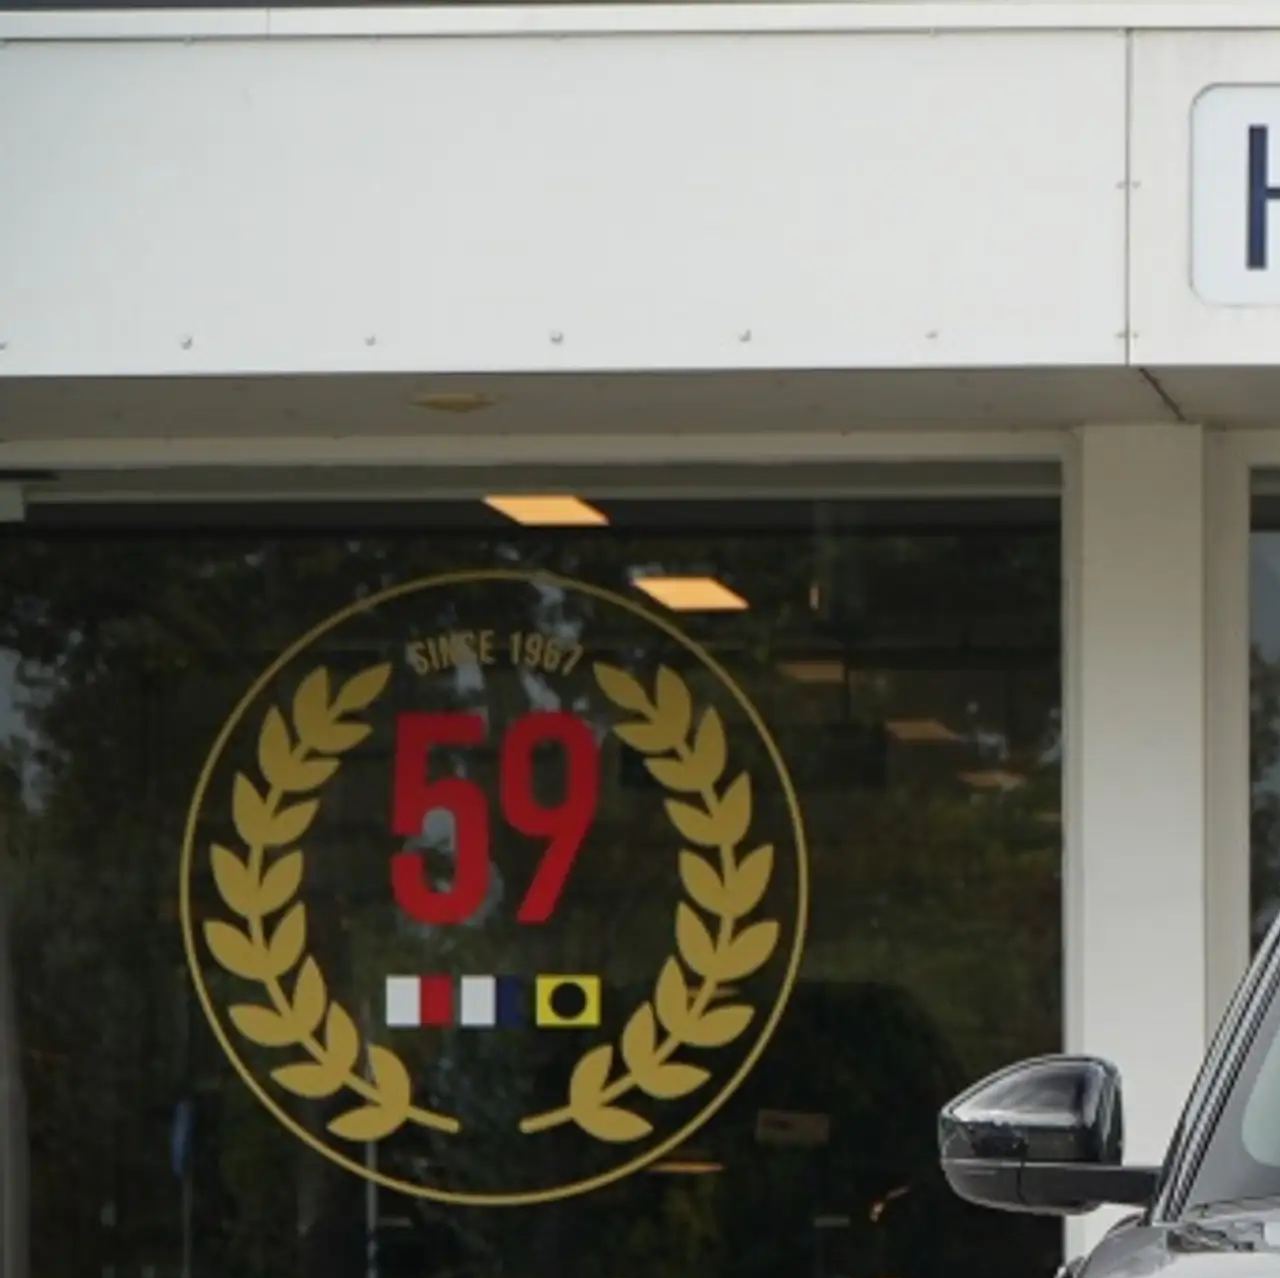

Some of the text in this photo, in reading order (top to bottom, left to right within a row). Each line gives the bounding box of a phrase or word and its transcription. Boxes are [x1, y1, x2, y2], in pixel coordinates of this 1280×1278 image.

[405, 628, 585, 678] SINCE 1967
[389, 710, 602, 926] 59
